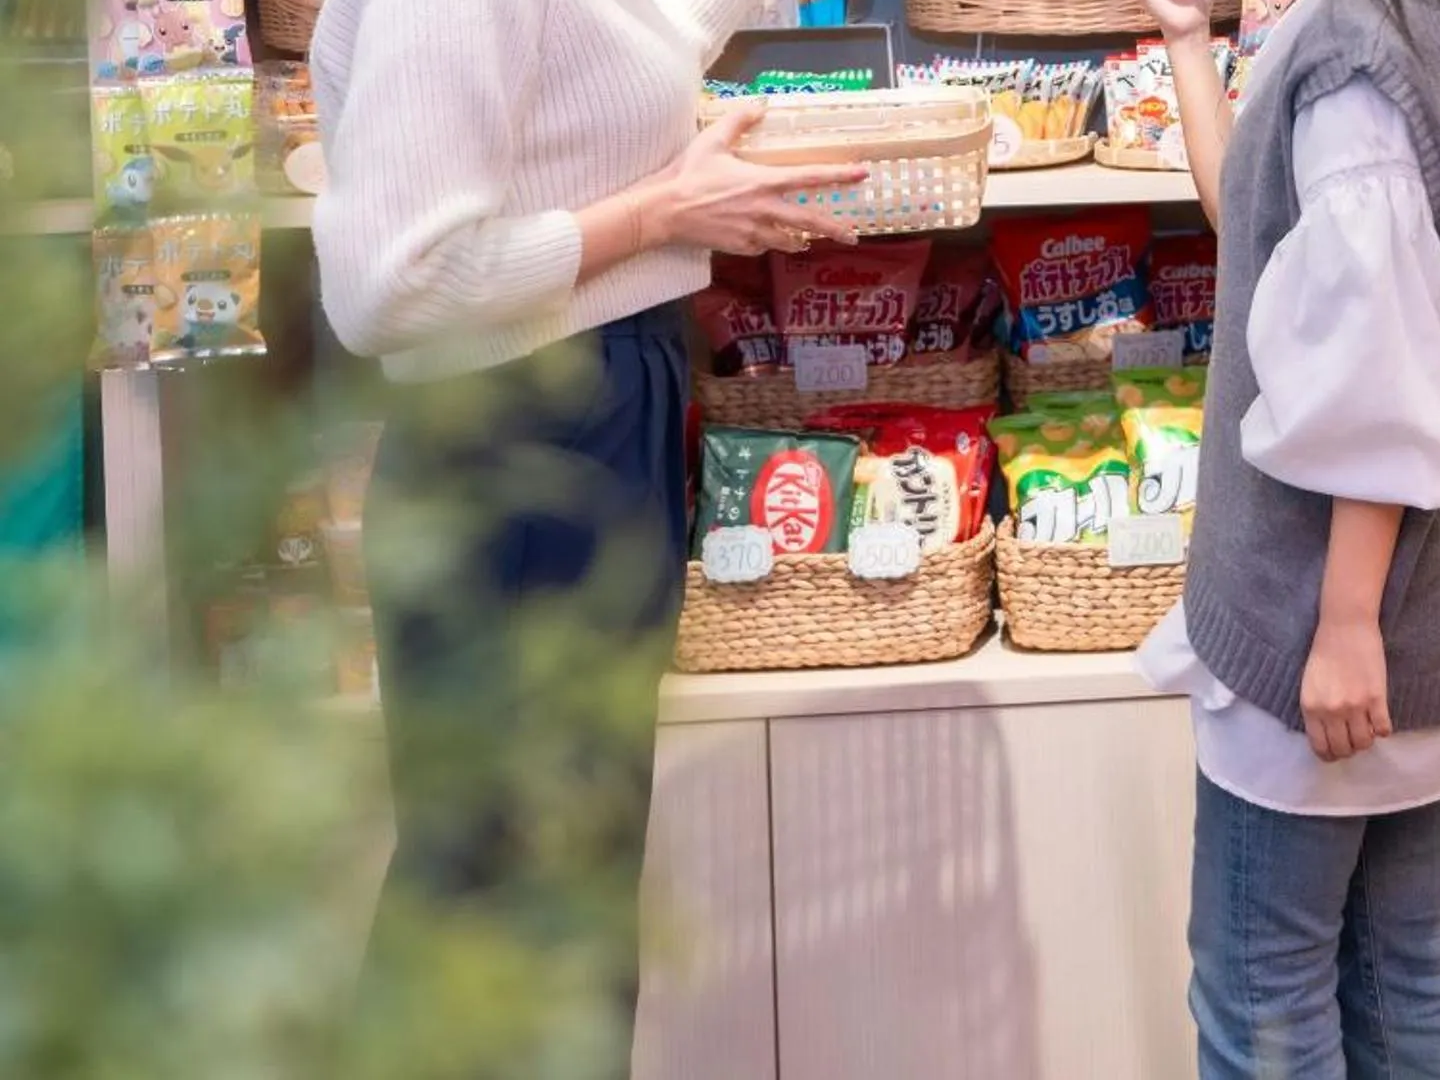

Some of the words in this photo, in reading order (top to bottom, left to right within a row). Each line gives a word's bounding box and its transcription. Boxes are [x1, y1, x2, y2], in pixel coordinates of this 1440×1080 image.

[1040, 234, 1106, 260] Calbee
[1019, 244, 1138, 307] ポテトチップス
[785, 289, 909, 332] ポテトチップス
[766, 471, 819, 548] KitKat
